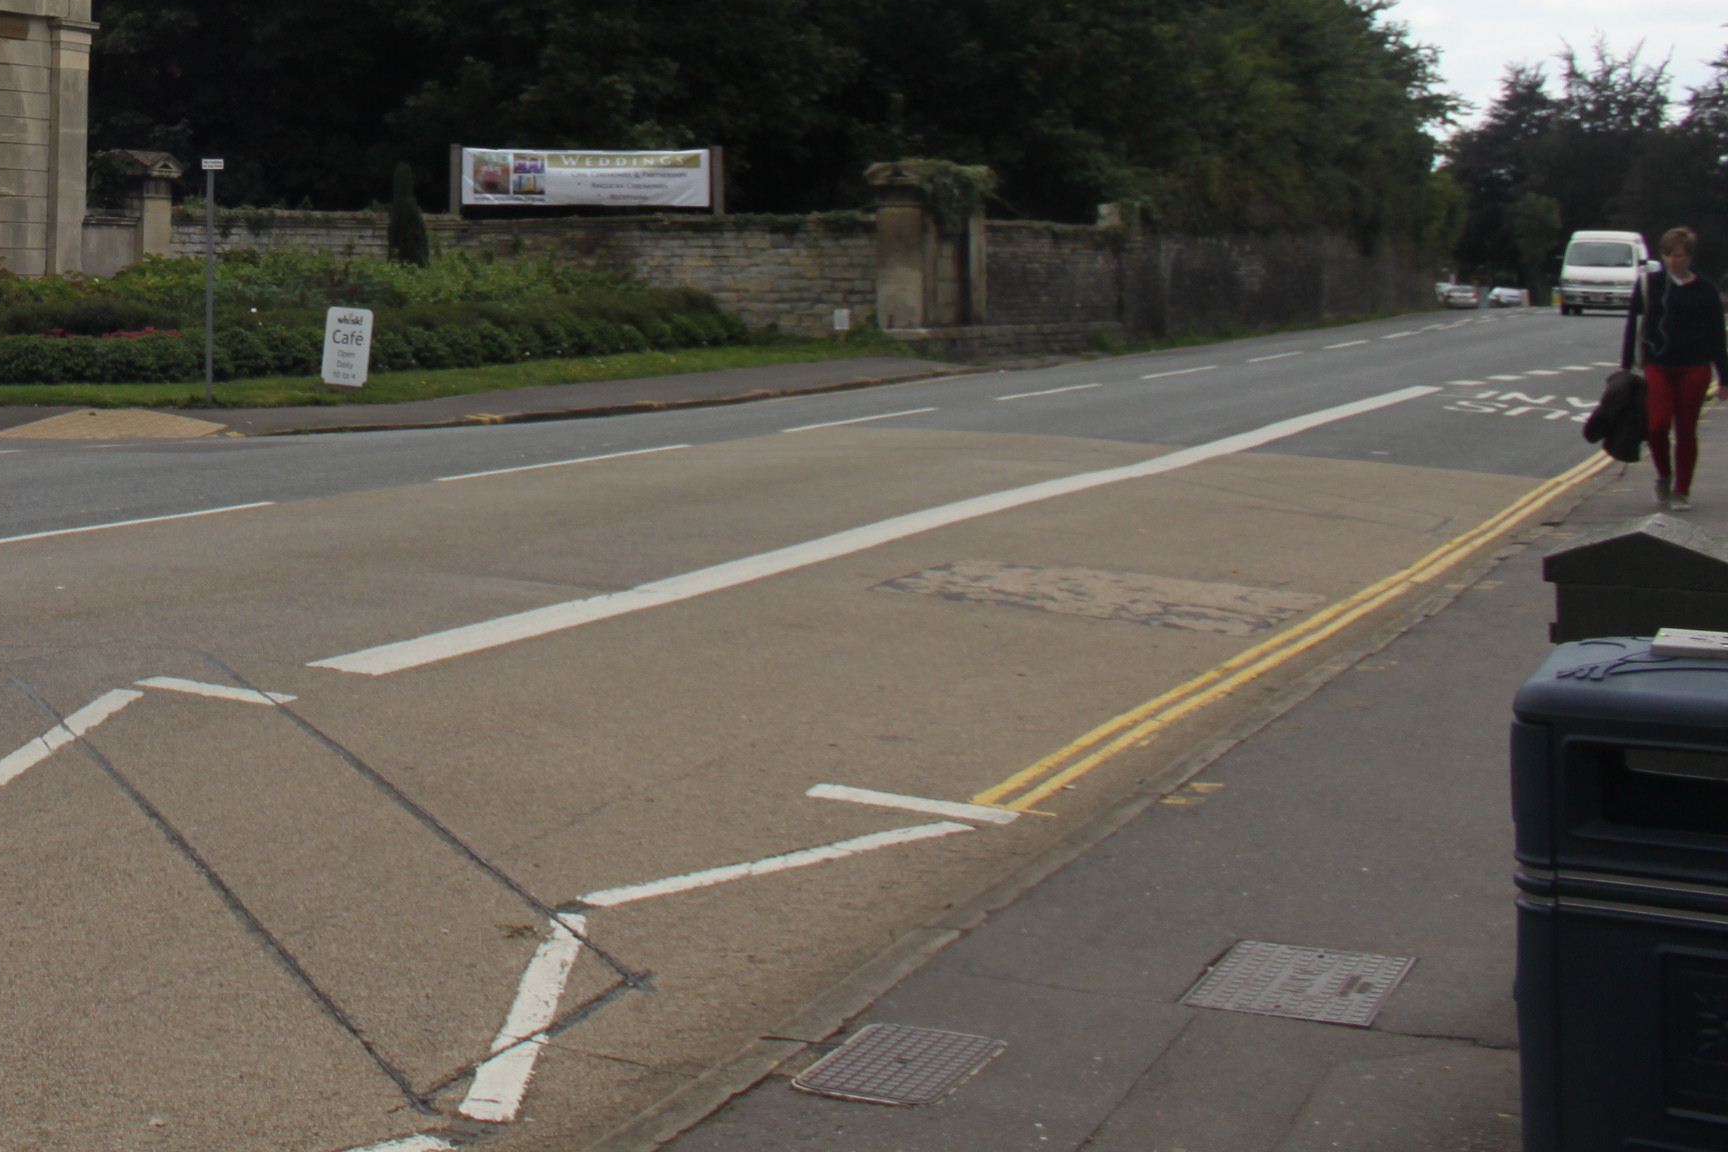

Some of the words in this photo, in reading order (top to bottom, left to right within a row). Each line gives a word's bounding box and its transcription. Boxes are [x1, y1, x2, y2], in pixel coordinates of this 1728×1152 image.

[560, 154, 685, 167] WEDDINGS
[332, 329, 364, 346] Café
[337, 349, 356, 359] Open
[336, 360, 354, 370] Daily
